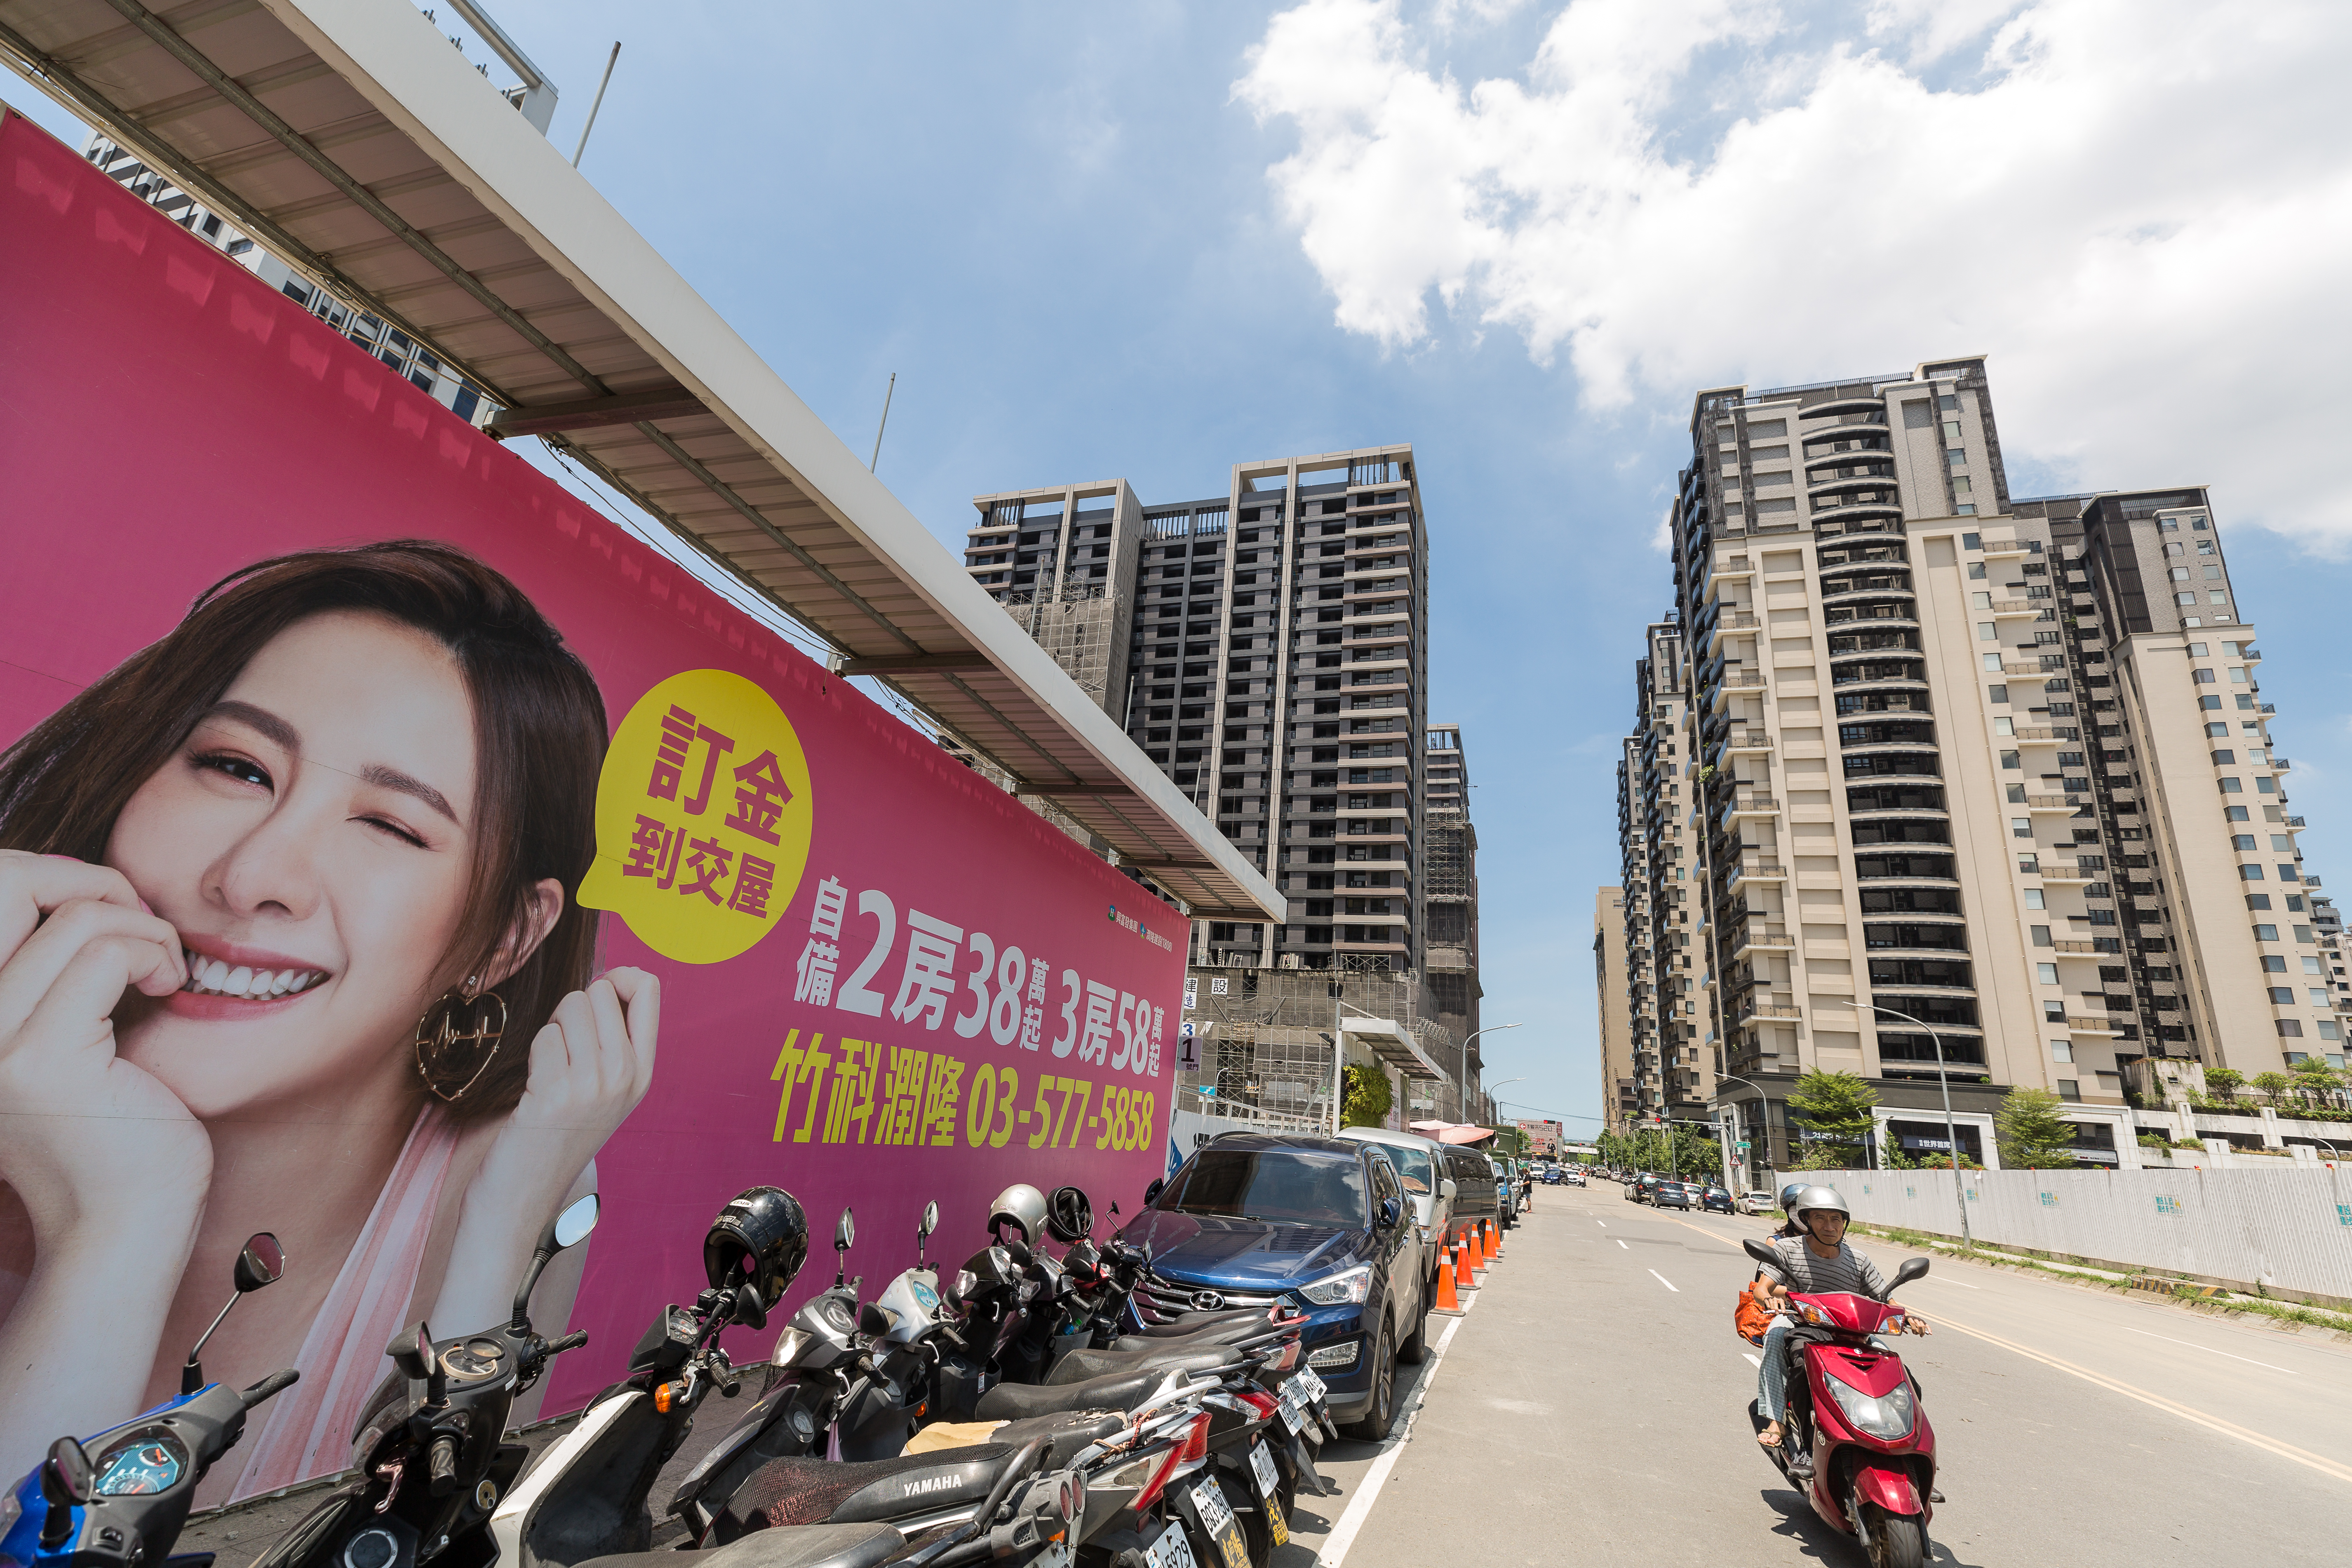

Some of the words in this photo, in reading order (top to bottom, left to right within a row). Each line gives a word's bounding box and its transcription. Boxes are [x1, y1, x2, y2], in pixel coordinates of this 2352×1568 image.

[647, 704, 793, 846] 訂金
[623, 813, 775, 919] 到交屋
[1116, 911, 1138, 933] 興富發集團
[771, 1028, 966, 1146] 竹科潤隆
[966, 1063, 1154, 1151] 03-577-5858
[903, 1474, 962, 1497] YAMAHA
